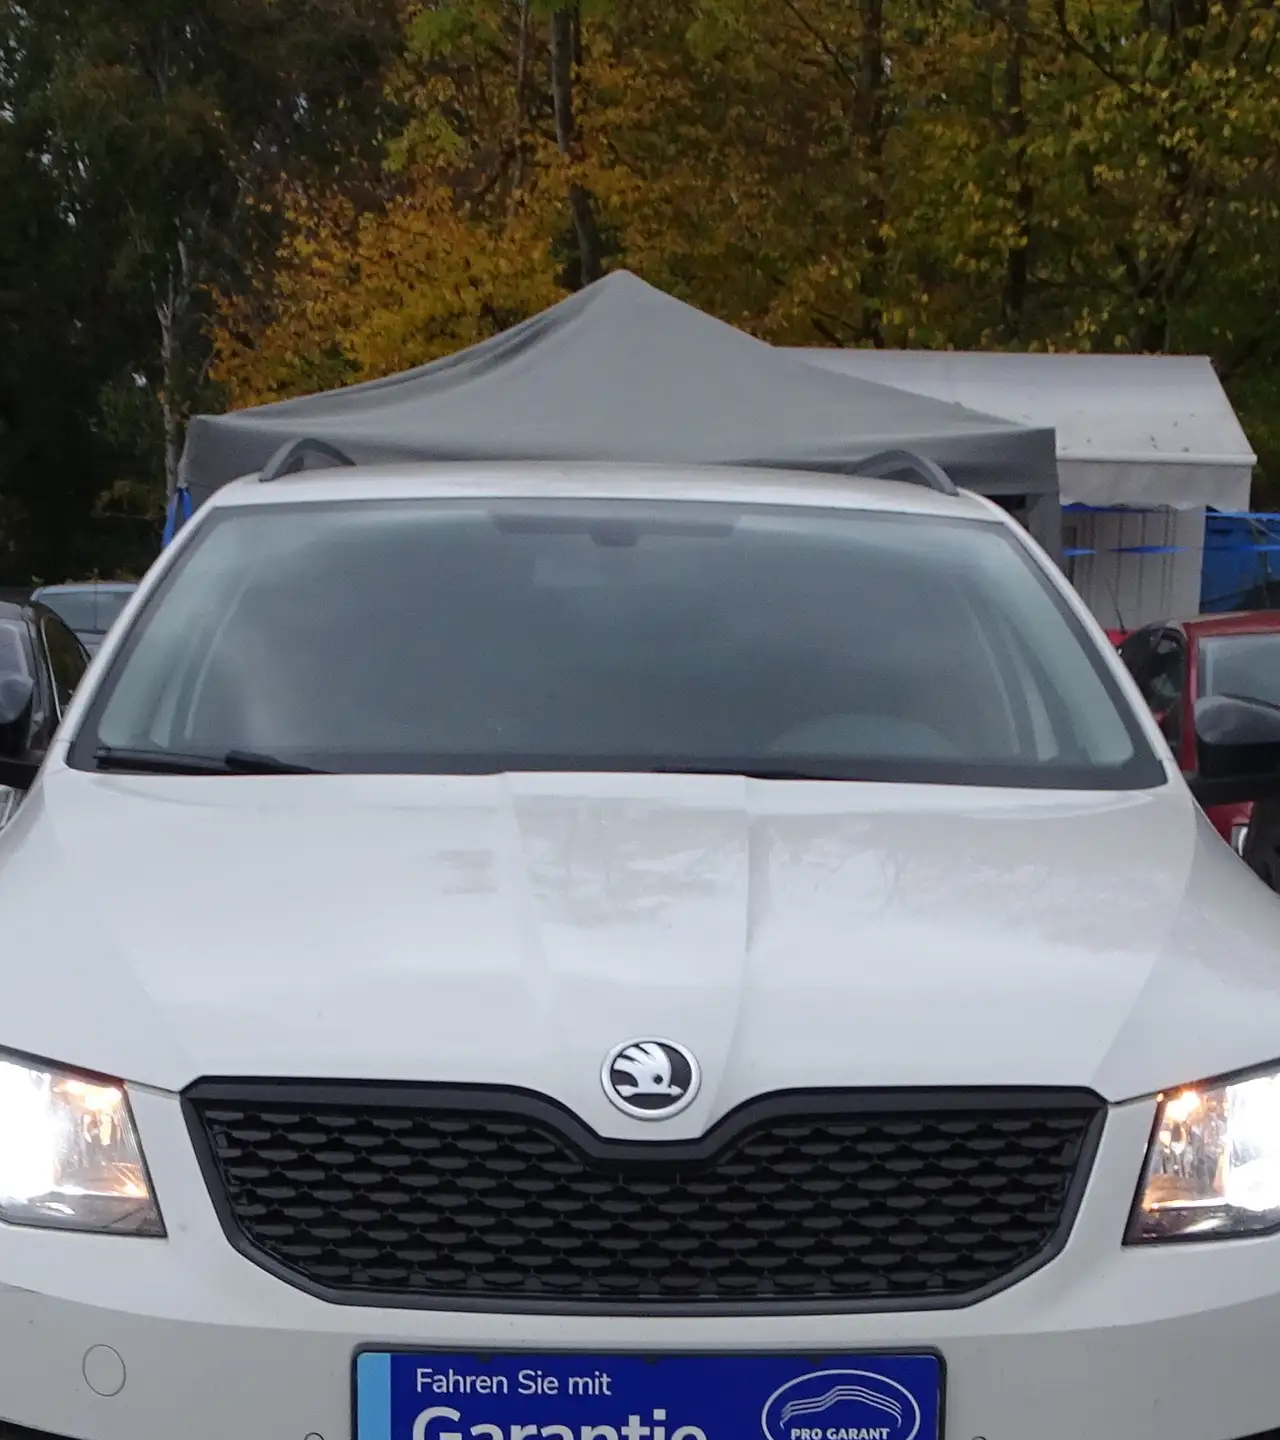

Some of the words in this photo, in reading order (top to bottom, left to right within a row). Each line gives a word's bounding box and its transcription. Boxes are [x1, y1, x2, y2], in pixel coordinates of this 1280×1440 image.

[416, 1368, 508, 1394] Fahren
[518, 1370, 559, 1395] Sie
[568, 1371, 612, 1395] mit
[790, 1427, 823, 1440] PRO
[826, 1427, 890, 1440] GARANT
